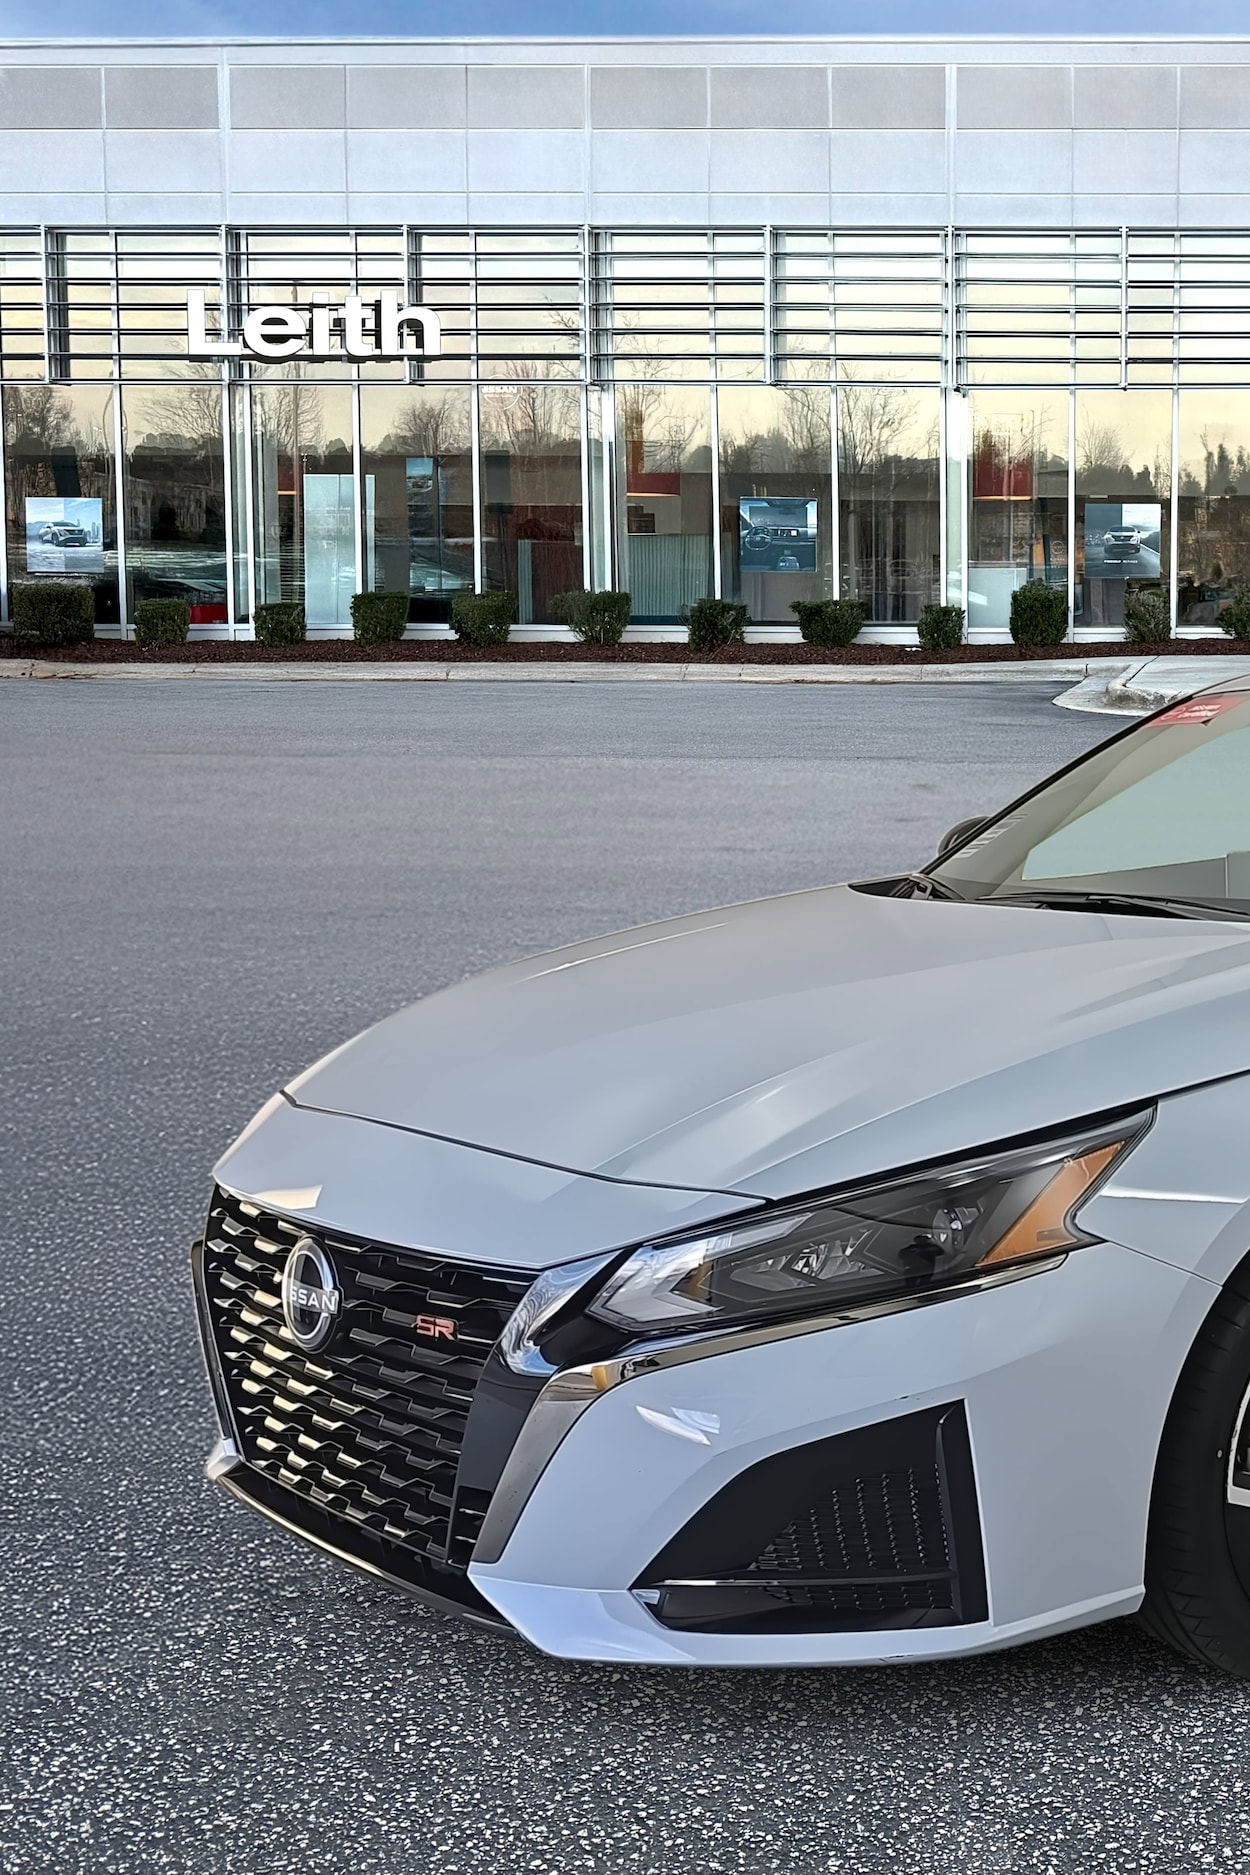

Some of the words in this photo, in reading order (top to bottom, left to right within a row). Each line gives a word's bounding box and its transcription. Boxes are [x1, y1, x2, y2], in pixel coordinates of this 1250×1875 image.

[187, 289, 441, 357] Leith
[290, 1286, 336, 1312] SSAN
[416, 1314, 456, 1341] SR
